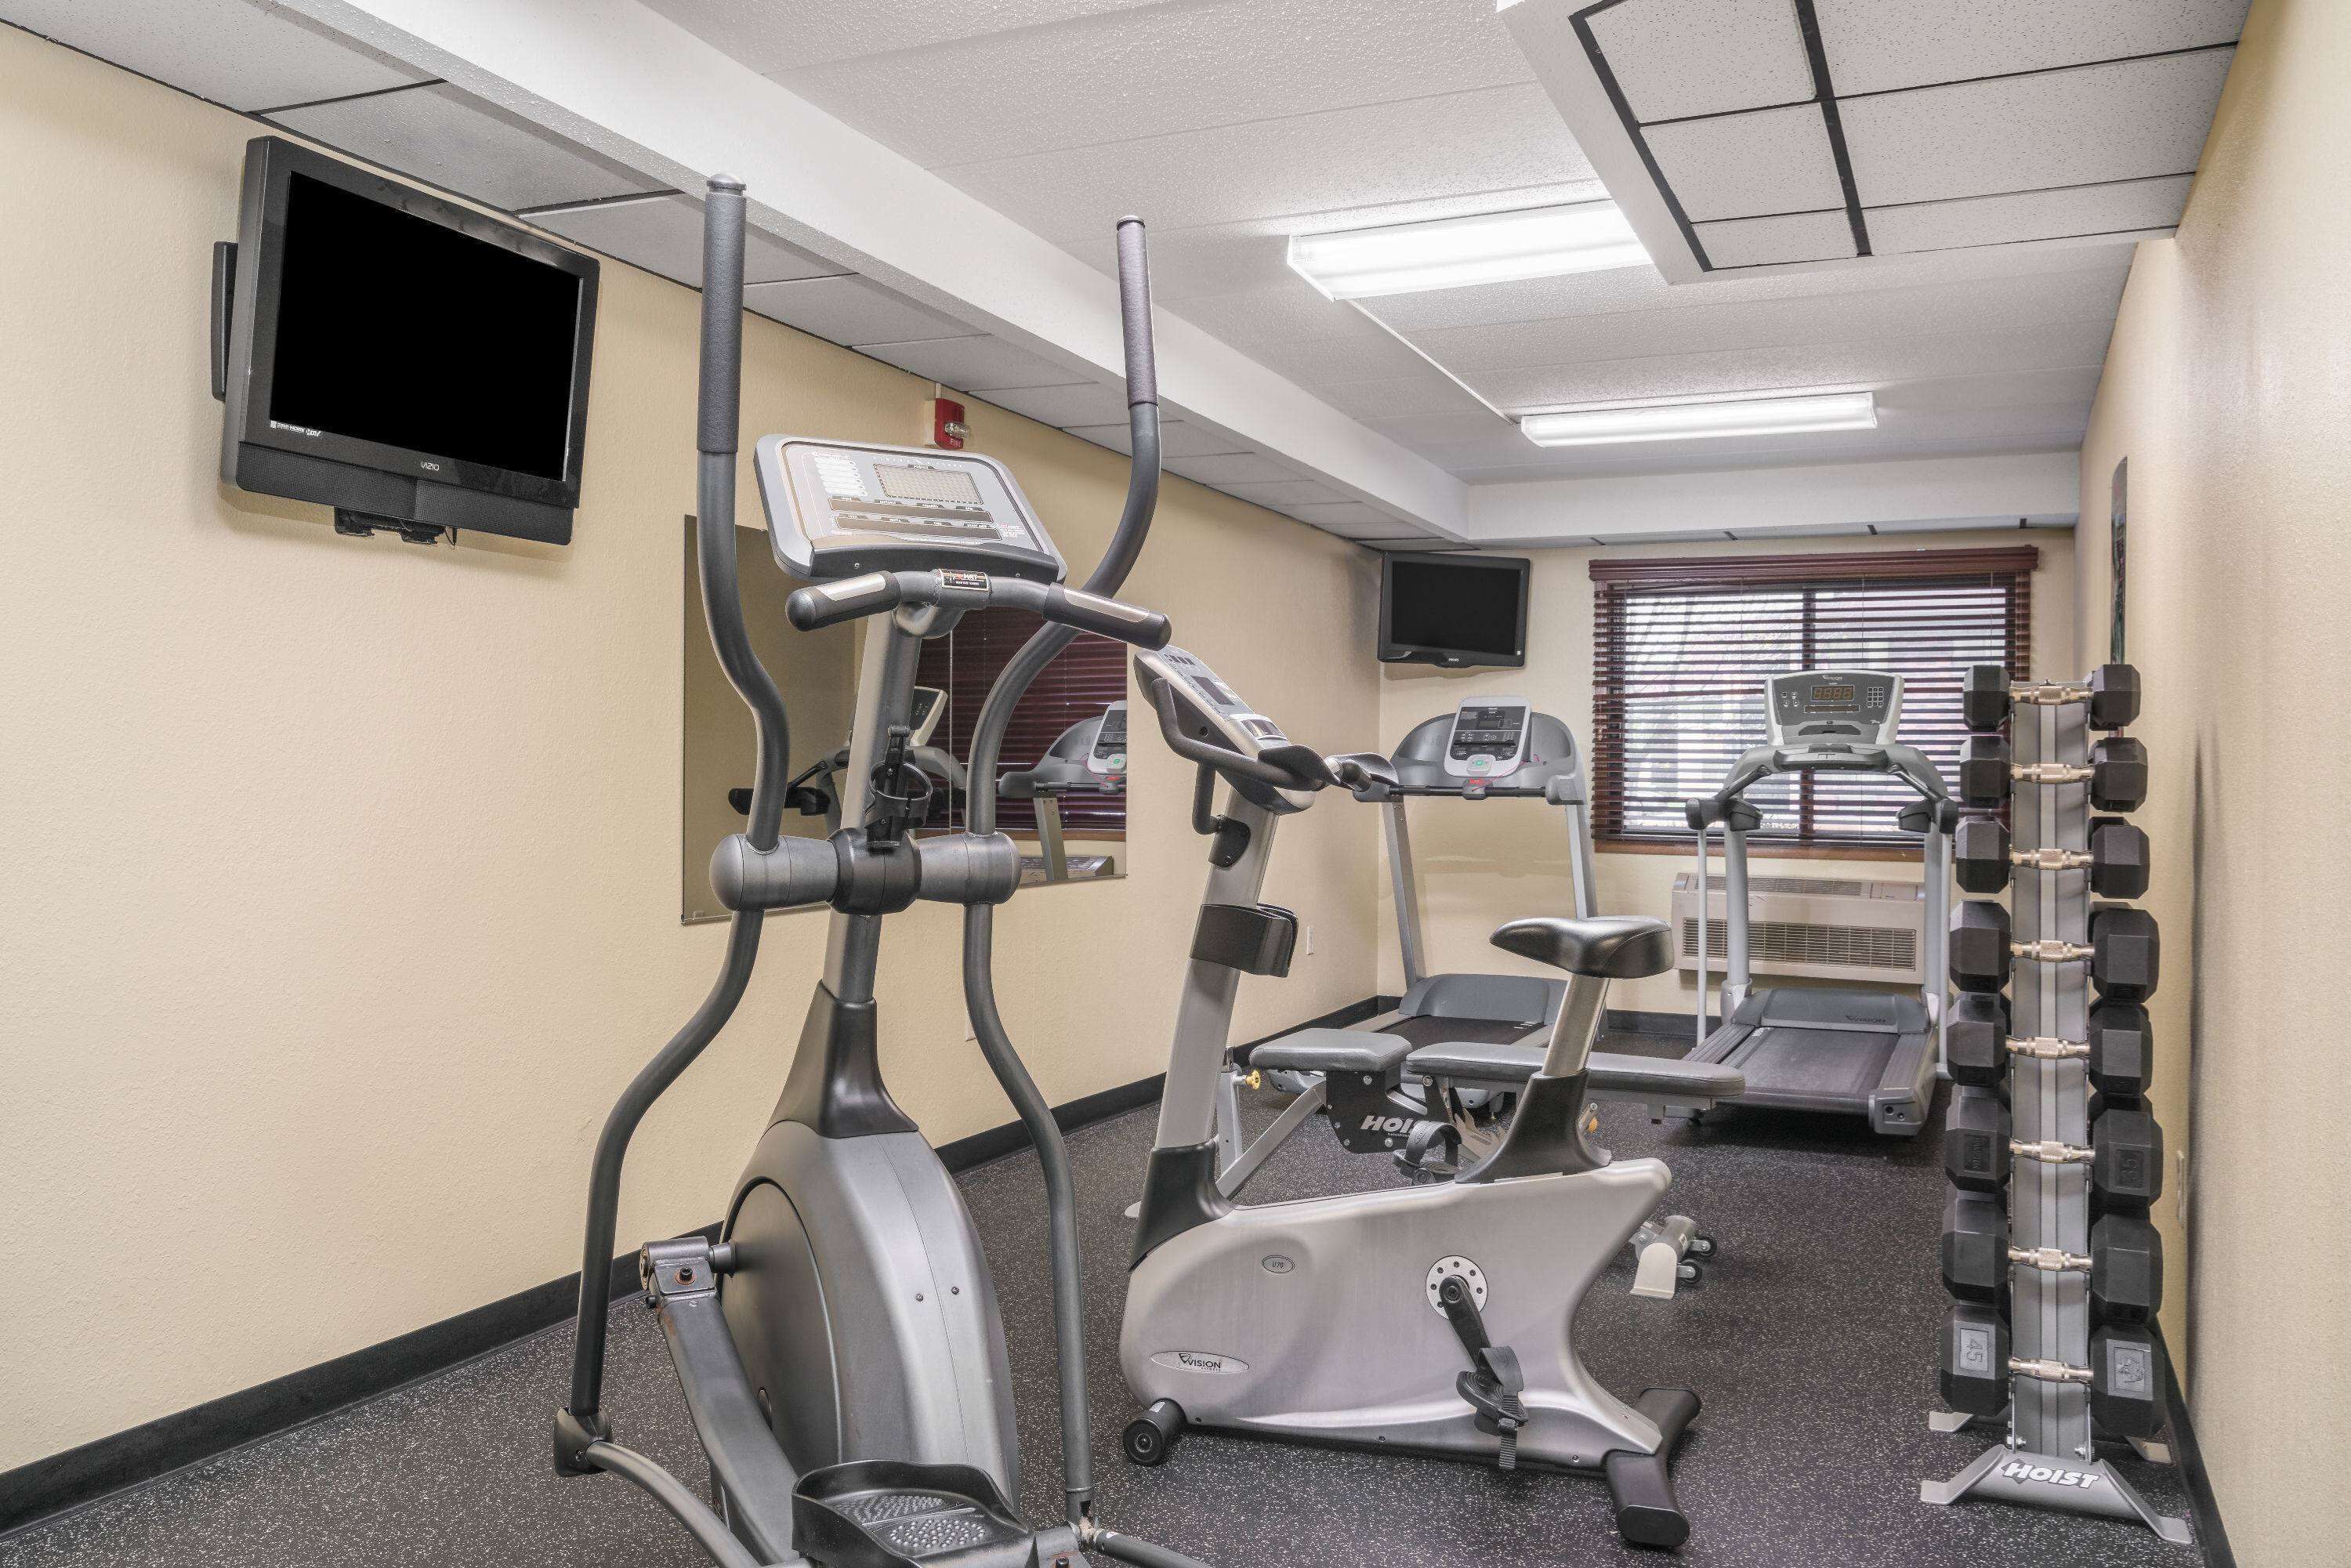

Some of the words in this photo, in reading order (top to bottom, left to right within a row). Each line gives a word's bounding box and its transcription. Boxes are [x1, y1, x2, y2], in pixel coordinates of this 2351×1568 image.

[949, 438, 962, 447] FIRE
[421, 461, 440, 471] VIZIO
[1360, 1115, 1415, 1134] HOI
[1187, 1359, 1222, 1370] VISION
[2003, 1462, 2100, 1489] HOIST
